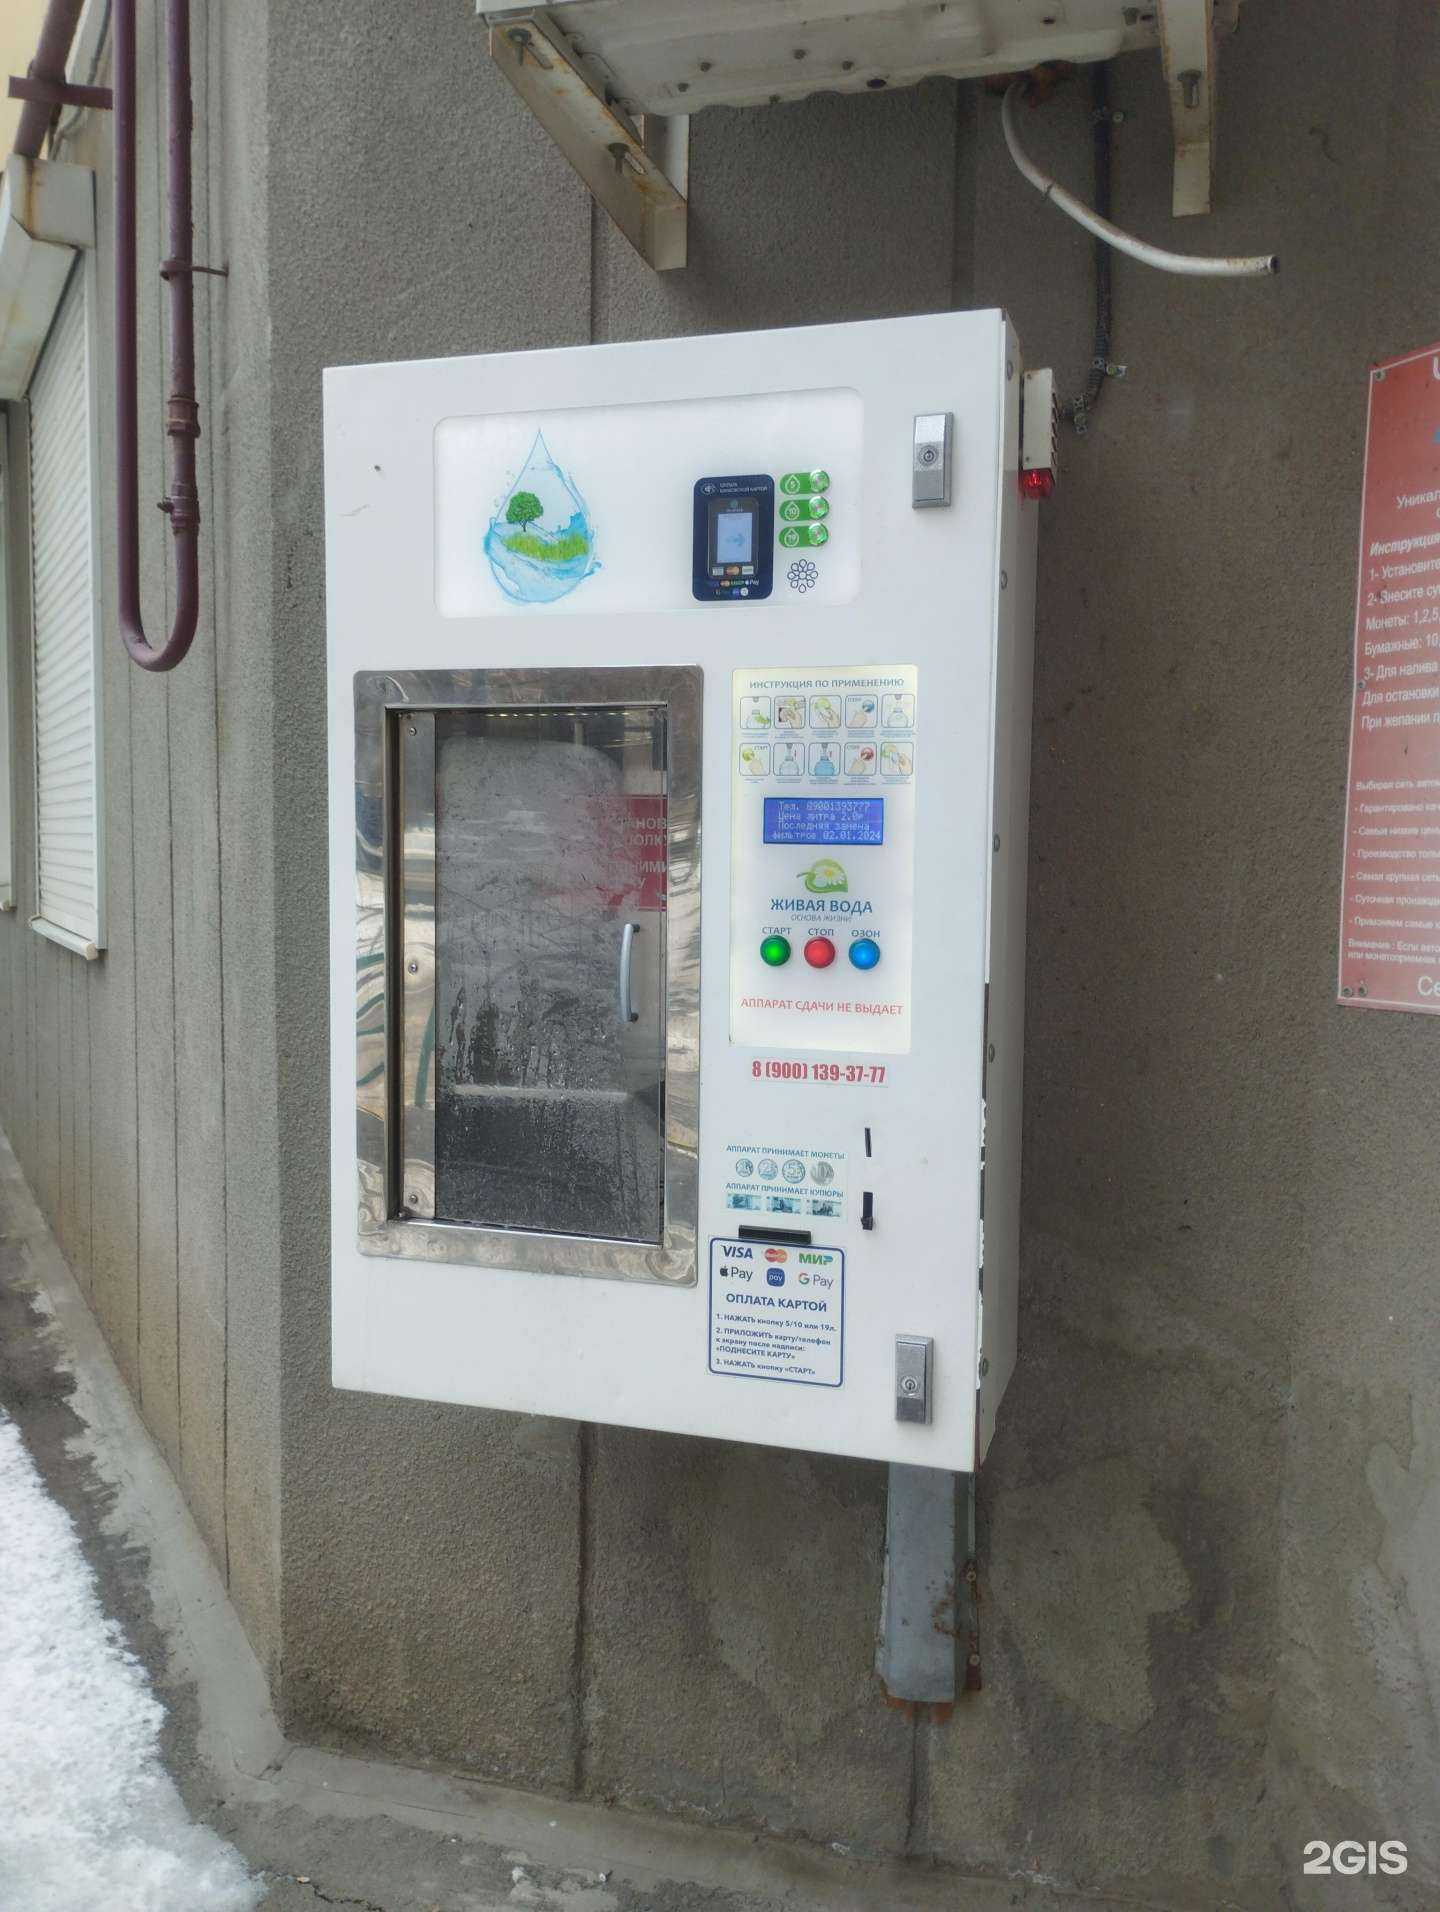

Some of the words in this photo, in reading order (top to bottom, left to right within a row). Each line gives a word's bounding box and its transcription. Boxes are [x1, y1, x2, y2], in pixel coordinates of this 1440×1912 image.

[1366, 615, 1409, 631] Монеты:
[1365, 638, 1422, 657] Бумажные:
[1364, 666, 1374, 680] 3-
[1376, 664, 1397, 680] Для
[1400, 660, 1438, 676] налива
[750, 679, 813, 690] ИНСТРУКЦИЯ
[815, 680, 829, 688] ПО
[832, 679, 905, 688] ПРИМЕНЕНИЮ
[1362, 690, 1383, 707] Для
[1361, 715, 1382, 732] При
[1385, 712, 1430, 727] желании
[778, 801, 799, 811] Тел.
[778, 821, 830, 831] Последняя
[835, 822, 870, 832] замена
[823, 830, 881, 841] 02.01.2024
[771, 899, 824, 912] ЖИВАЯ
[830, 900, 873, 915] ВОДА
[791, 914, 821, 922] ОСНОВА
[762, 926, 791, 935] СТАРТ
[808, 928, 834, 937] СТОП
[851, 929, 880, 938] ОЗОН
[741, 998, 793, 1010] АППАРАТ
[795, 1000, 834, 1013] СДАЧИ
[837, 1003, 852, 1012] НЕ
[855, 1004, 904, 1016] ВЫДАЕТ
[752, 1060, 762, 1078] 8
[766, 1061, 808, 1080] (900)
[811, 1063, 886, 1083] 139-37-77
[726, 1145, 760, 1154] АППАРАТ
[762, 1147, 809, 1157] ПРИНИМАЕТ
[811, 1151, 845, 1160] МОНЕТЫ
[726, 1182, 760, 1191] АППАРАТ
[761, 1185, 808, 1195] ПРИНИМАЕТ
[810, 1189, 844, 1198] КУПЮРЫ
[721, 1245, 753, 1259] VISA
[799, 1253, 834, 1265] МИР
[731, 1266, 753, 1282] Pay
[769, 1274, 783, 1282] pay
[798, 1272, 810, 1285] G
[813, 1274, 834, 1289] Pay
[726, 1293, 776, 1308] ОПЛАТА
[778, 1297, 827, 1312] КАРТОЙ
[724, 1314, 756, 1323] НАЖАТЬ
[757, 1317, 784, 1327] кнопку
[785, 1320, 803, 1329] 5/10
[722, 1338, 747, 1347] экрану
[772, 1343, 806, 1351] надписи:
[724, 1328, 773, 1339] ПРИЛОЖИТЬ
[774, 1333, 831, 1346] карту/телефон
[716, 1346, 766, 1357] «ПОДНЕСИТЕ
[767, 1350, 796, 1360] КАРТУ»
[724, 1359, 756, 1369] НАЖАТЬ
[757, 1364, 783, 1373] кнопку
[785, 1366, 816, 1375] «СТАРТ»
